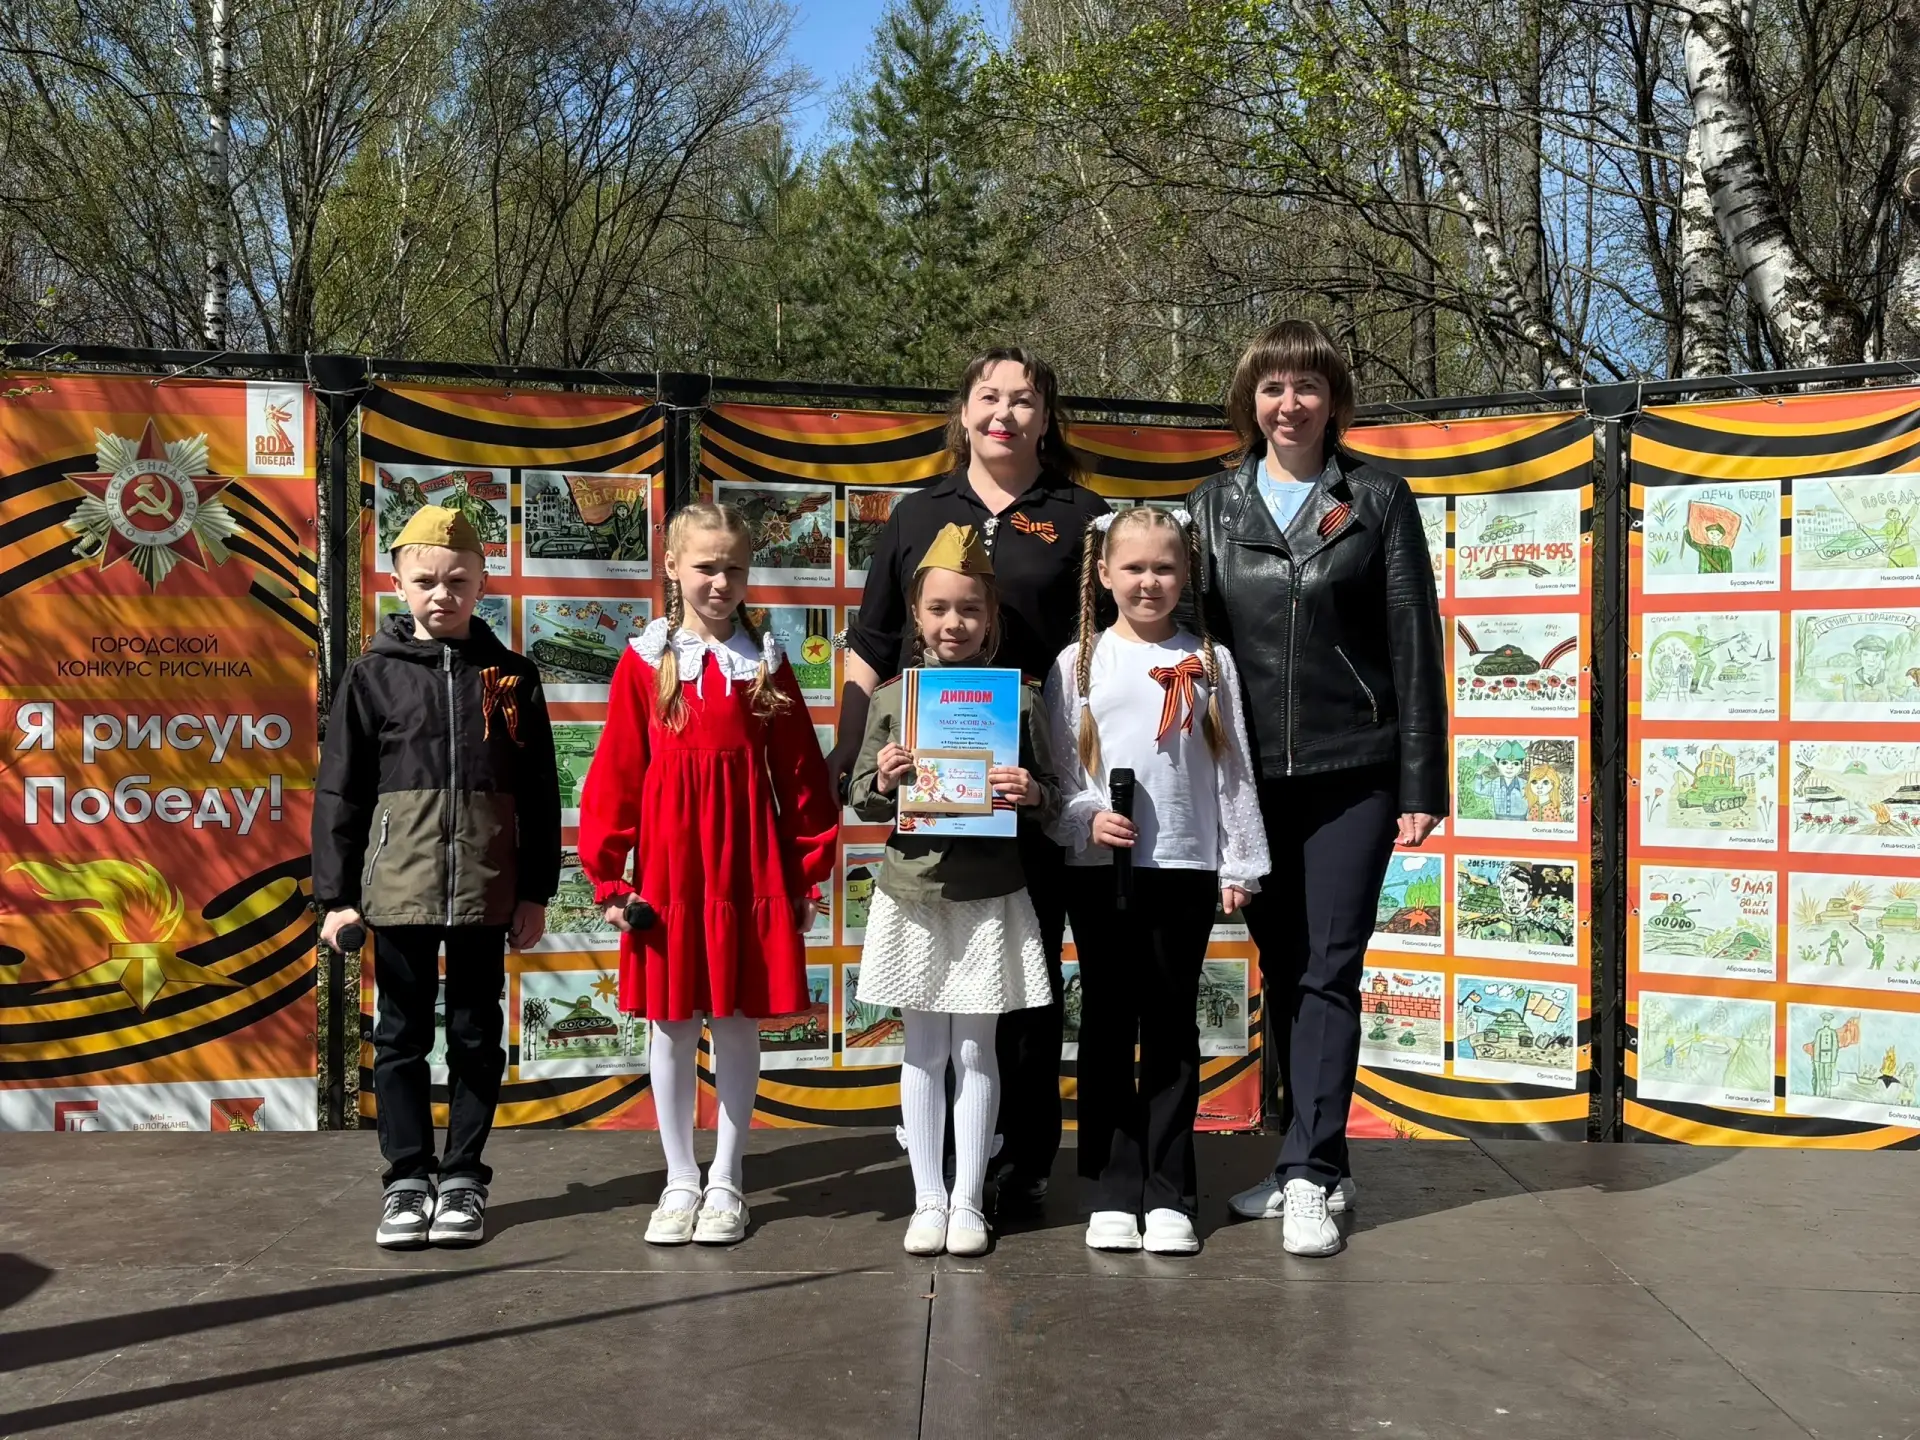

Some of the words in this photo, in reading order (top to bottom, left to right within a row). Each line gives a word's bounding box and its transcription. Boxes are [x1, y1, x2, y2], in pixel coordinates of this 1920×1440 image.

[255, 435, 277, 453] 80
[255, 456, 295, 466] ПОБЕДА!
[108, 462, 188, 537] ОТЕЧЕСТВЕННАЯ
[168, 490, 196, 537] ВОЙНА
[1699, 489, 1733, 501] ДЕНЬ
[1739, 489, 1776, 501] ПОБЕДЫ
[91, 633, 219, 656] ГОРОДСКОЙ
[57, 660, 153, 678] КОНКУРС
[160, 660, 252, 678] РИСУНКА
[940, 690, 993, 704] ДИПЛОМ
[15, 702, 55, 751] Я
[82, 712, 293, 764] рисую
[956, 784, 966, 798] 9
[23, 773, 283, 836] Победу!
[1730, 877, 1740, 892] 9
[1742, 881, 1772, 894] МАЯ
[133, 1121, 189, 1131] ВОЛОГЖАНЕ!
